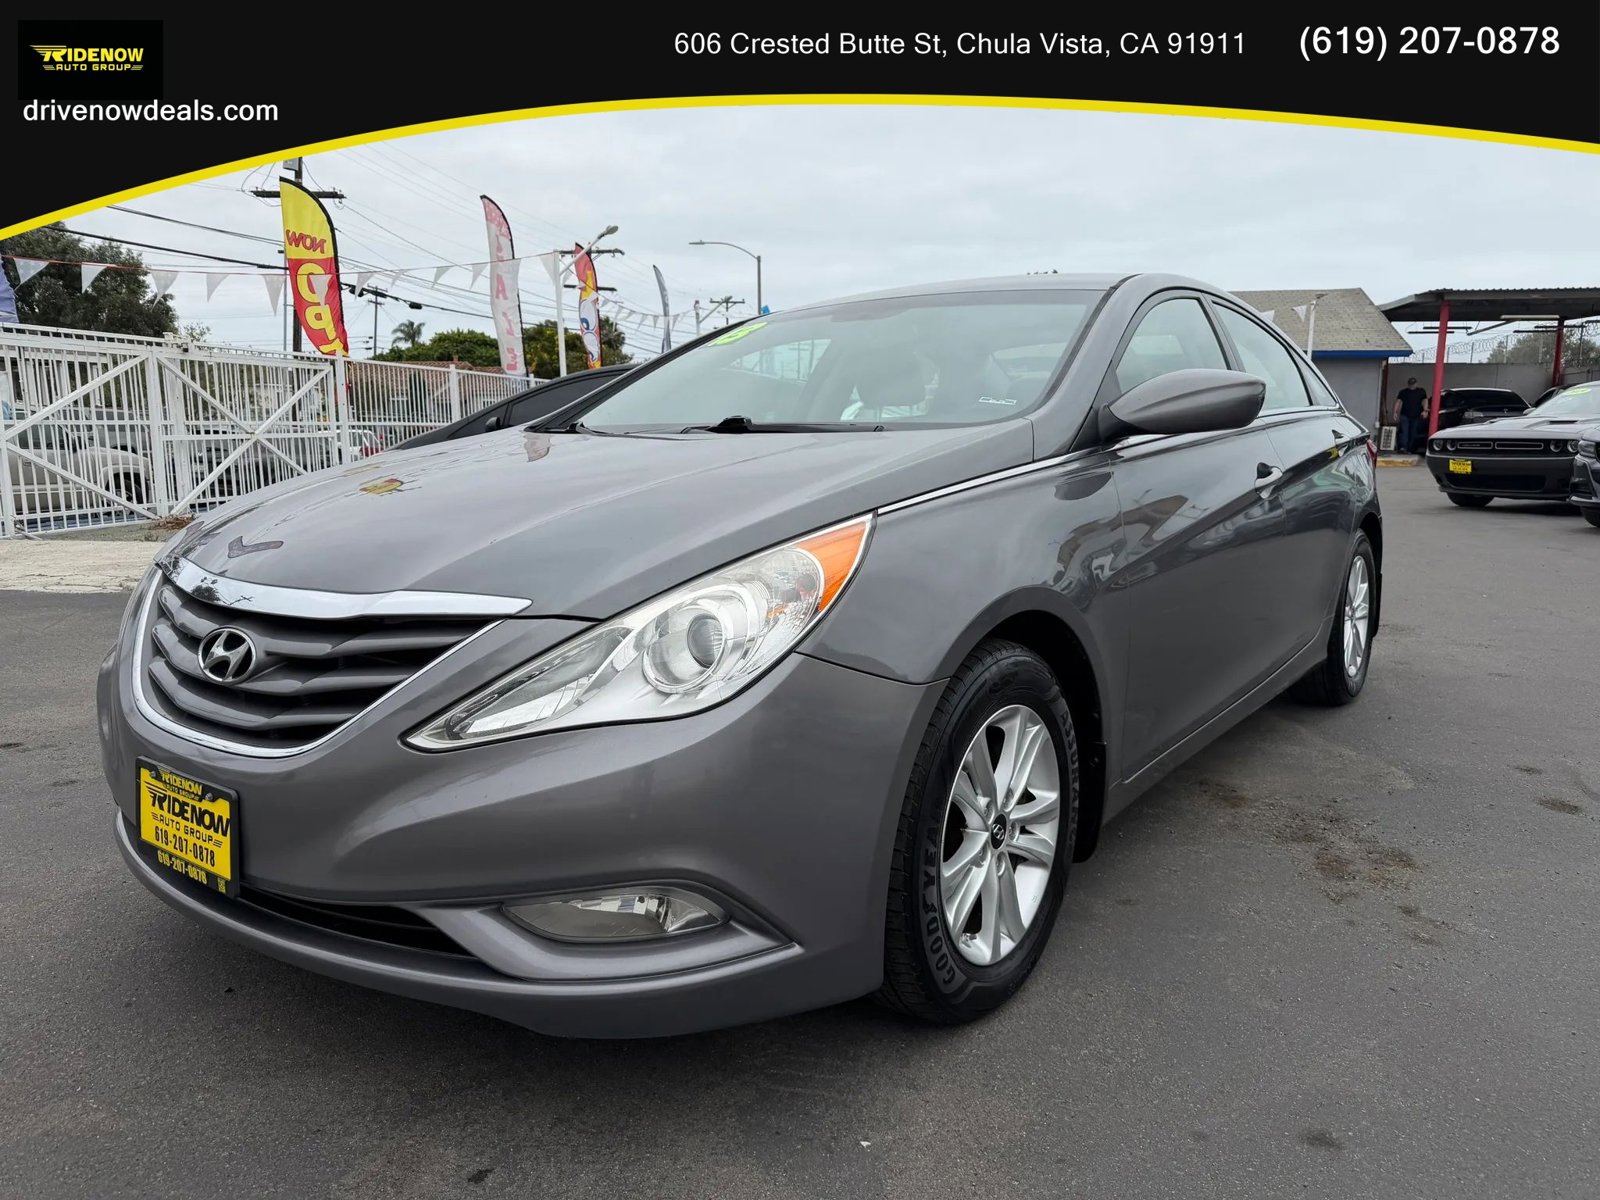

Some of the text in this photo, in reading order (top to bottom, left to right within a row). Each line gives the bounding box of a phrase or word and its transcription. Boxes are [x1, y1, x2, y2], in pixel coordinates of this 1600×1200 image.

[160, 772, 203, 796] RIDENOW
[147, 783, 231, 837] RIDENOW
[159, 814, 214, 843] AUTO GROUP
[155, 825, 216, 868] 619-207-0878
[157, 850, 208, 885] 619-207-0878
